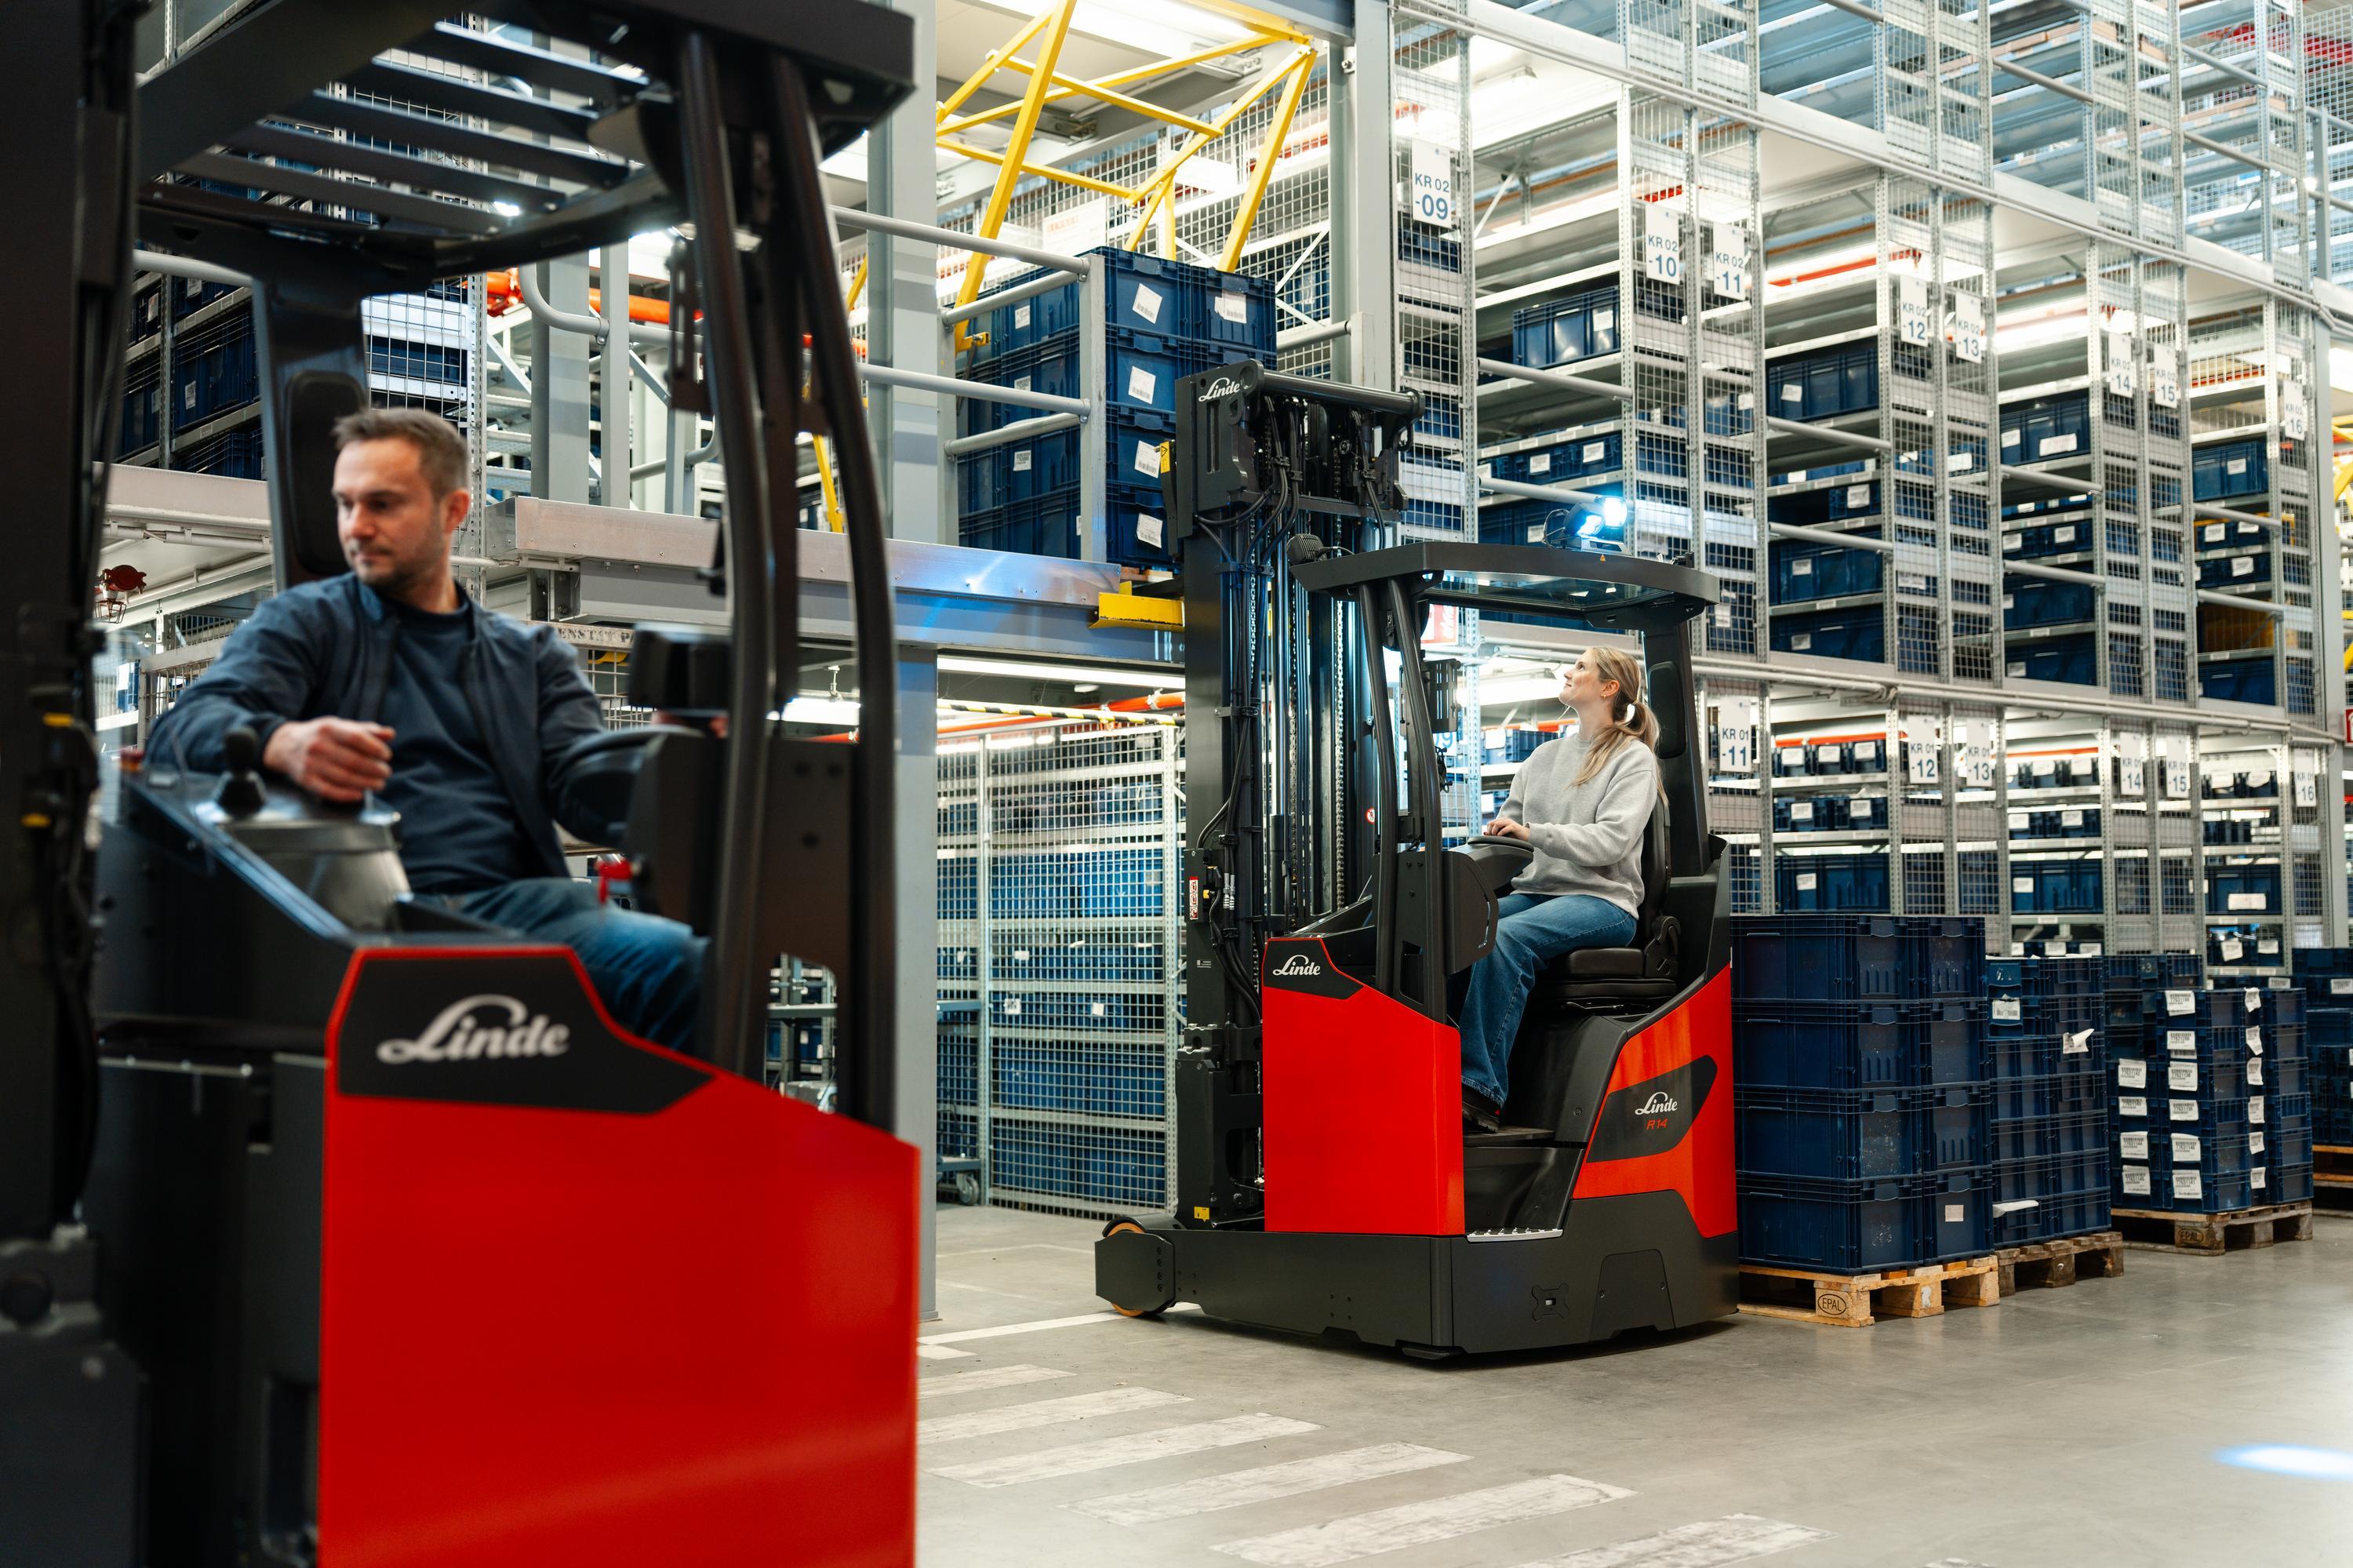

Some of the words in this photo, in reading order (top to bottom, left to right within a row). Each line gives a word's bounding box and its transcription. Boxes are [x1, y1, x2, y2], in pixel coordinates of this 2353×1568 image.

[1415, 173, 1432, 188] KR
[1435, 179, 1449, 193] 02
[1415, 194, 1449, 220] -09
[1648, 235, 1663, 249] KR
[1665, 239, 1678, 252] 02
[1649, 254, 1677, 277] -10
[1715, 252, 1730, 265] KR
[1732, 256, 1744, 268] 02
[1716, 271, 1740, 293] -11
[1903, 302, 1915, 314] KR
[1916, 306, 1927, 317] 02
[1903, 319, 1926, 340] -12
[1958, 319, 1969, 329] KR
[1970, 324, 1980, 335] 02
[1958, 337, 1980, 357] -13
[2111, 358, 2121, 368] KR
[2122, 360, 2130, 370] 02
[2111, 373, 2131, 391] -14
[2156, 369, 2166, 379] KR
[2167, 371, 2176, 381] 02
[1198, 377, 1240, 402] Linde
[2156, 384, 2176, 402] -15
[1722, 727, 1736, 740] KR
[1739, 729, 1749, 740] 01
[1722, 745, 1746, 766] -11
[1911, 744, 1922, 753] KR
[1926, 744, 1935, 754] 01
[1968, 747, 1980, 756] KR
[1982, 748, 1990, 757] 01
[1911, 759, 1935, 777] -12
[1968, 762, 1990, 780] -13
[2122, 758, 2132, 767] KR
[2134, 759, 2141, 767] 01
[2168, 760, 2177, 769] KR
[2180, 762, 2187, 770] 01
[2122, 773, 2141, 790] -14
[2169, 775, 2187, 791] -15
[1272, 955, 1321, 976] Linde
[376, 994, 570, 1064] Linde
[1635, 1091, 1678, 1115] Linde
[1646, 1118, 1668, 1130] R14
[1822, 1297, 1842, 1312] EPAL
